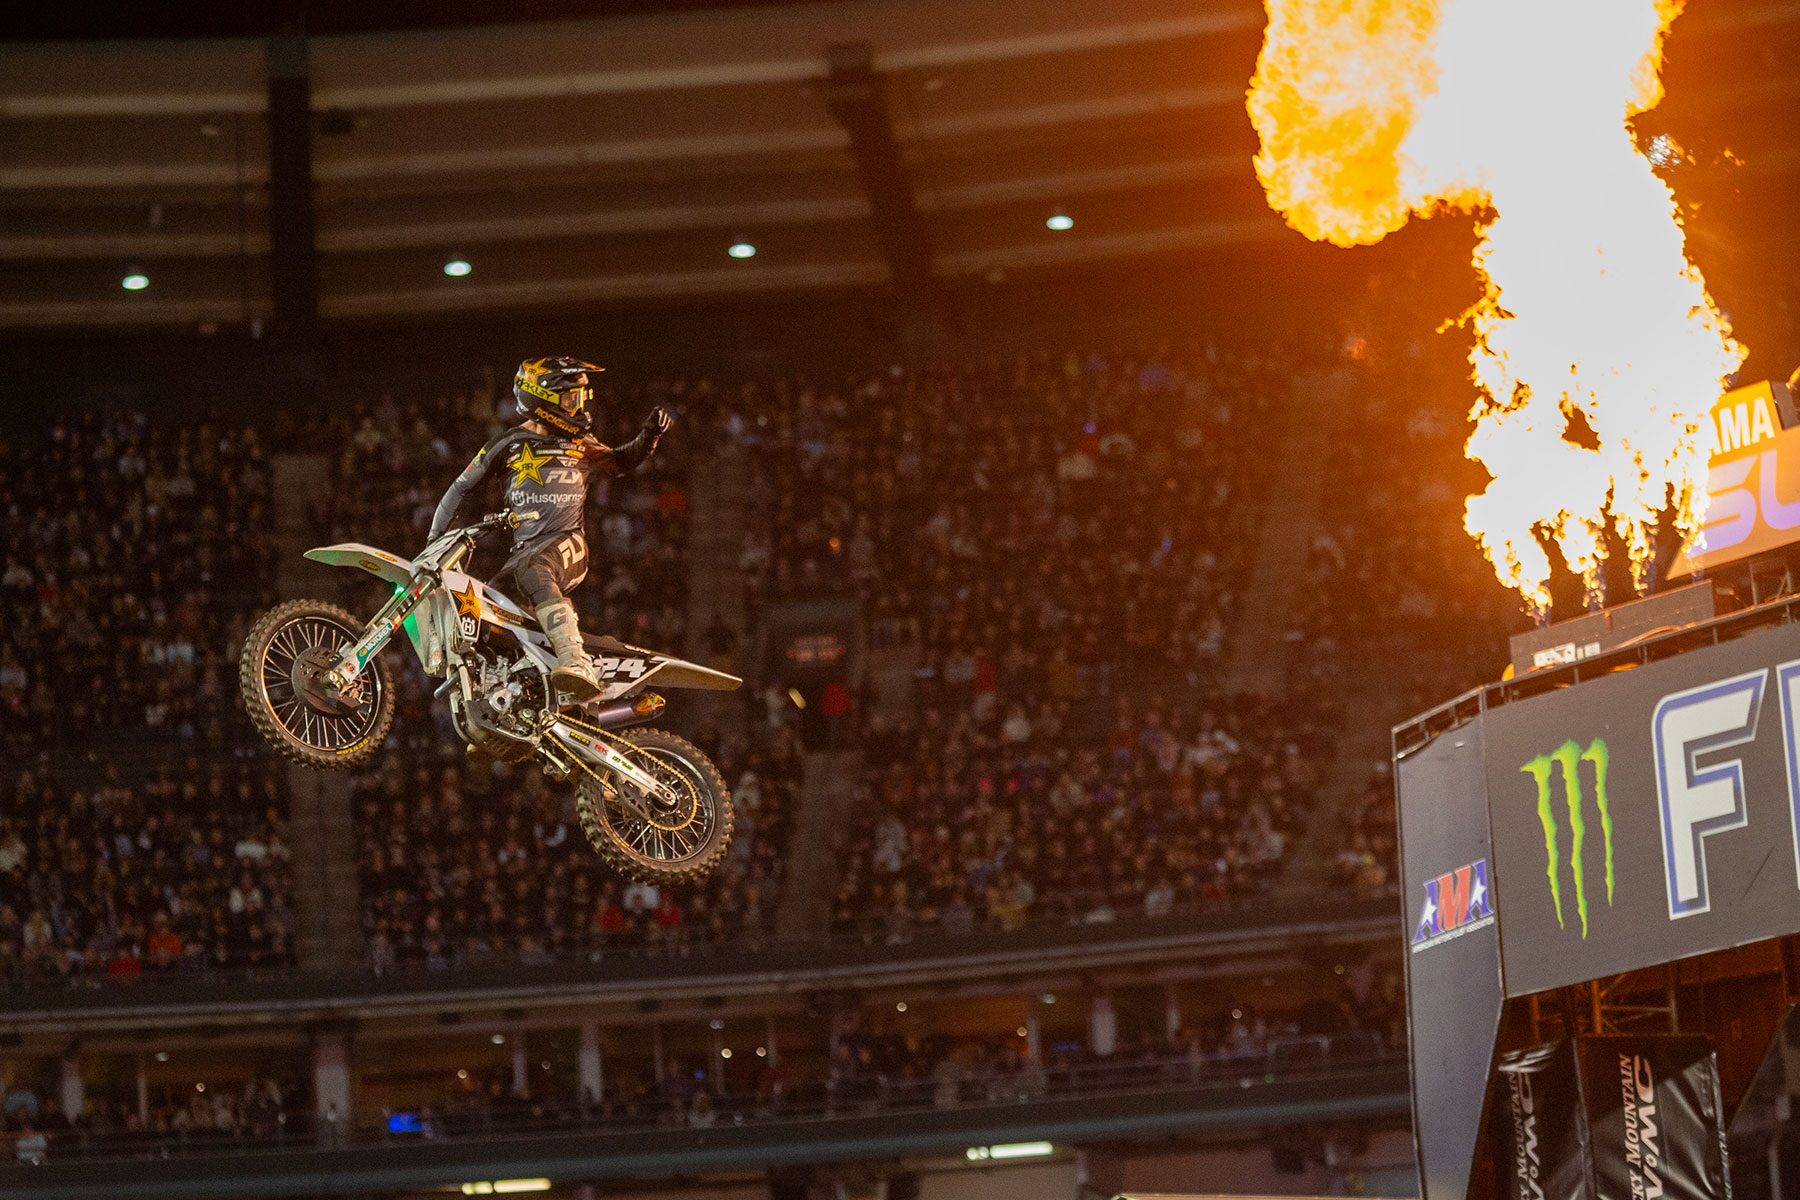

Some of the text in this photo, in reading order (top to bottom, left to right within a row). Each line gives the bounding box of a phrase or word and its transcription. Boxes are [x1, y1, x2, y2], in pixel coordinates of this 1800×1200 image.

[534, 407, 580, 435] ROCKSTAR
[365, 625, 392, 651] MOTOREX
[1411, 858, 1496, 946] AMA
[1618, 1053, 1642, 1169] MOUNTAIN
